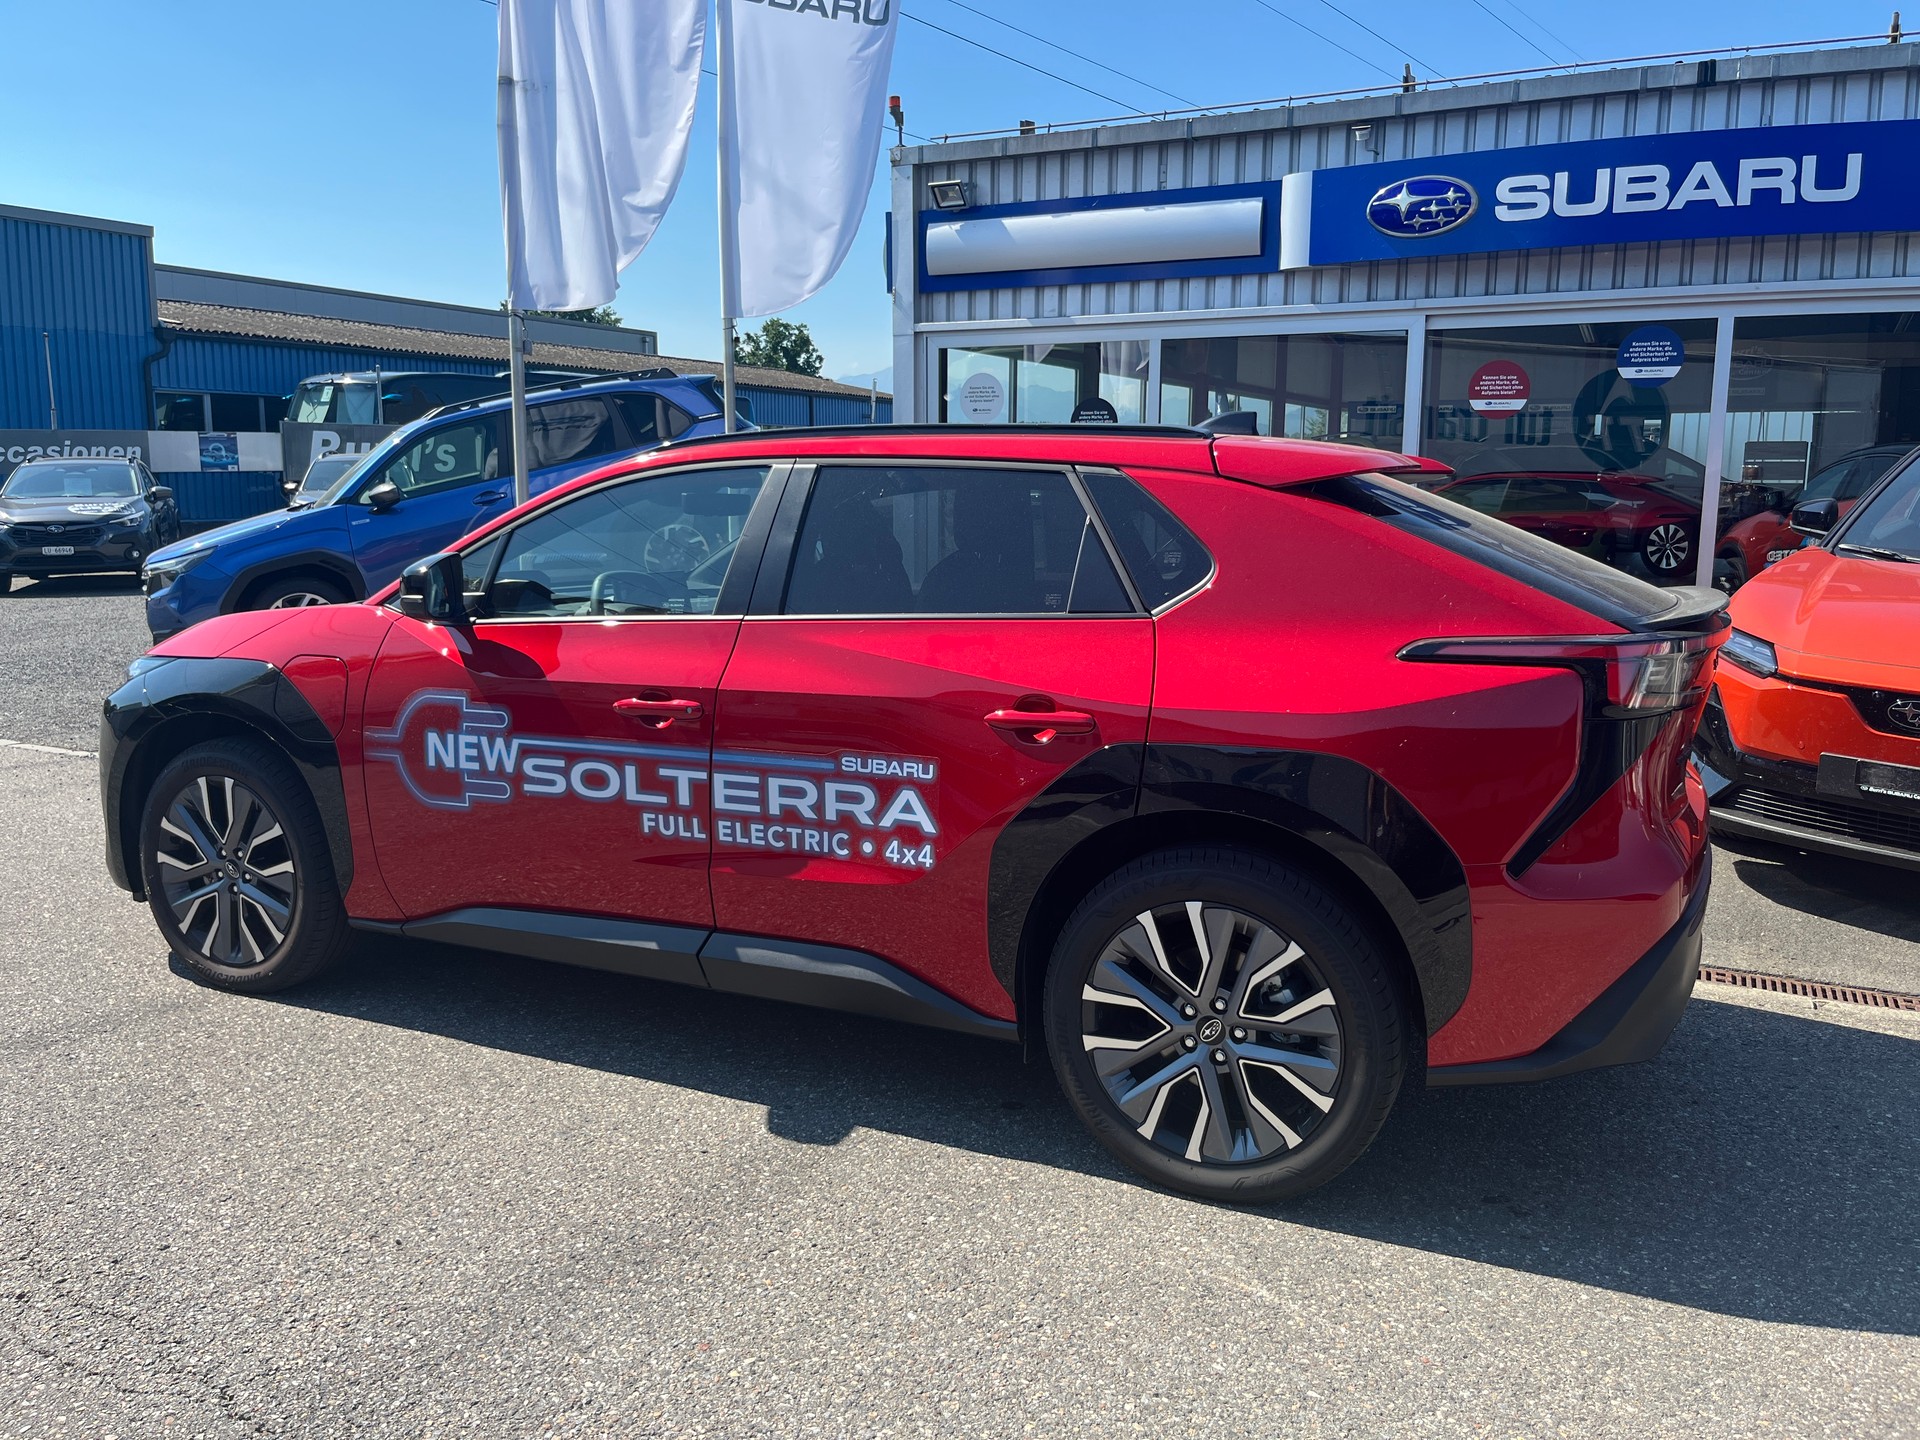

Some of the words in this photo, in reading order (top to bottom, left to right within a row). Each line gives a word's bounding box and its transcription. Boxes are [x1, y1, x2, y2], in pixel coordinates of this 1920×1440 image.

[1494, 153, 1863, 222] SUBARU
[427, 731, 520, 773] NEW
[841, 756, 935, 780] SUBARU
[523, 757, 937, 834] SOLTERRA
[642, 812, 706, 840] FULL
[717, 820, 850, 857] ELECTRIC
[885, 841, 934, 869] 4x4
